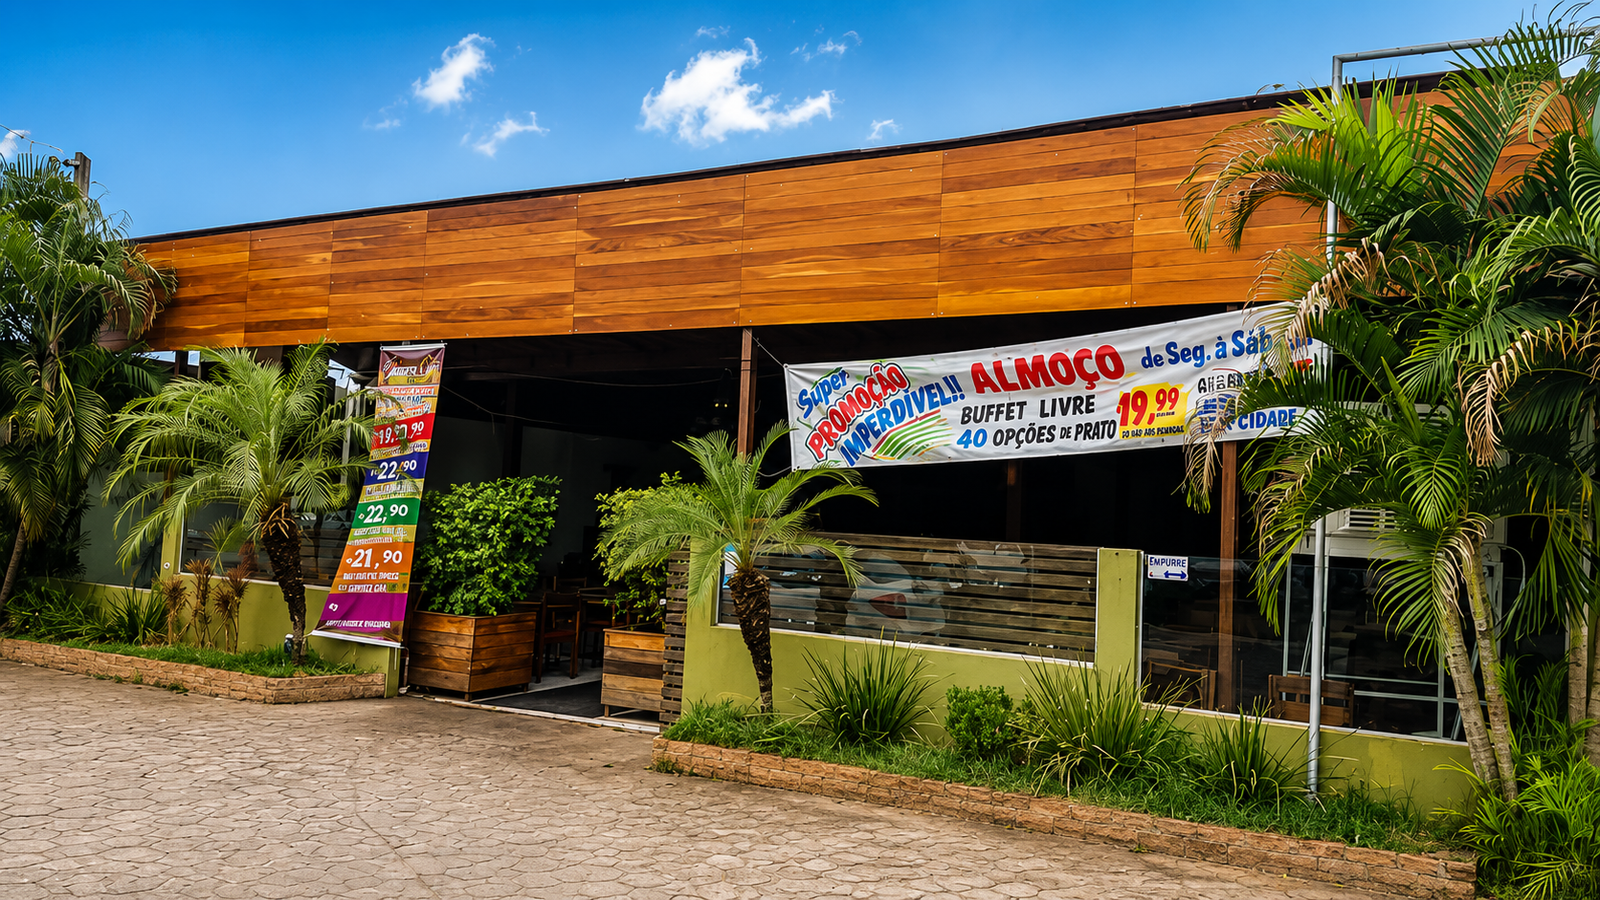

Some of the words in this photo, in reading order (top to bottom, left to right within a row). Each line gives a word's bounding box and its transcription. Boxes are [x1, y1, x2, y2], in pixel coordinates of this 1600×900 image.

[971, 344, 1125, 394] ALMOÇO
[1141, 346, 1164, 369] de
[1165, 341, 1211, 368] Seg.
[1215, 335, 1227, 359] à
[798, 368, 850, 419] Super
[807, 364, 909, 460] PROMOÇÃO
[960, 401, 1027, 425] BUFFET
[1040, 394, 1095, 419] LIVRE
[1116, 387, 1180, 427] 19,99
[839, 374, 965, 466] IMPERDÍVEL!!
[957, 428, 987, 449] 40
[993, 423, 1056, 449] OPÇÕES
[1060, 426, 1072, 439] DE
[1074, 419, 1116, 441] PRATO
[351, 548, 402, 570] 21,90
[1149, 556, 1187, 568] EMPURRE
